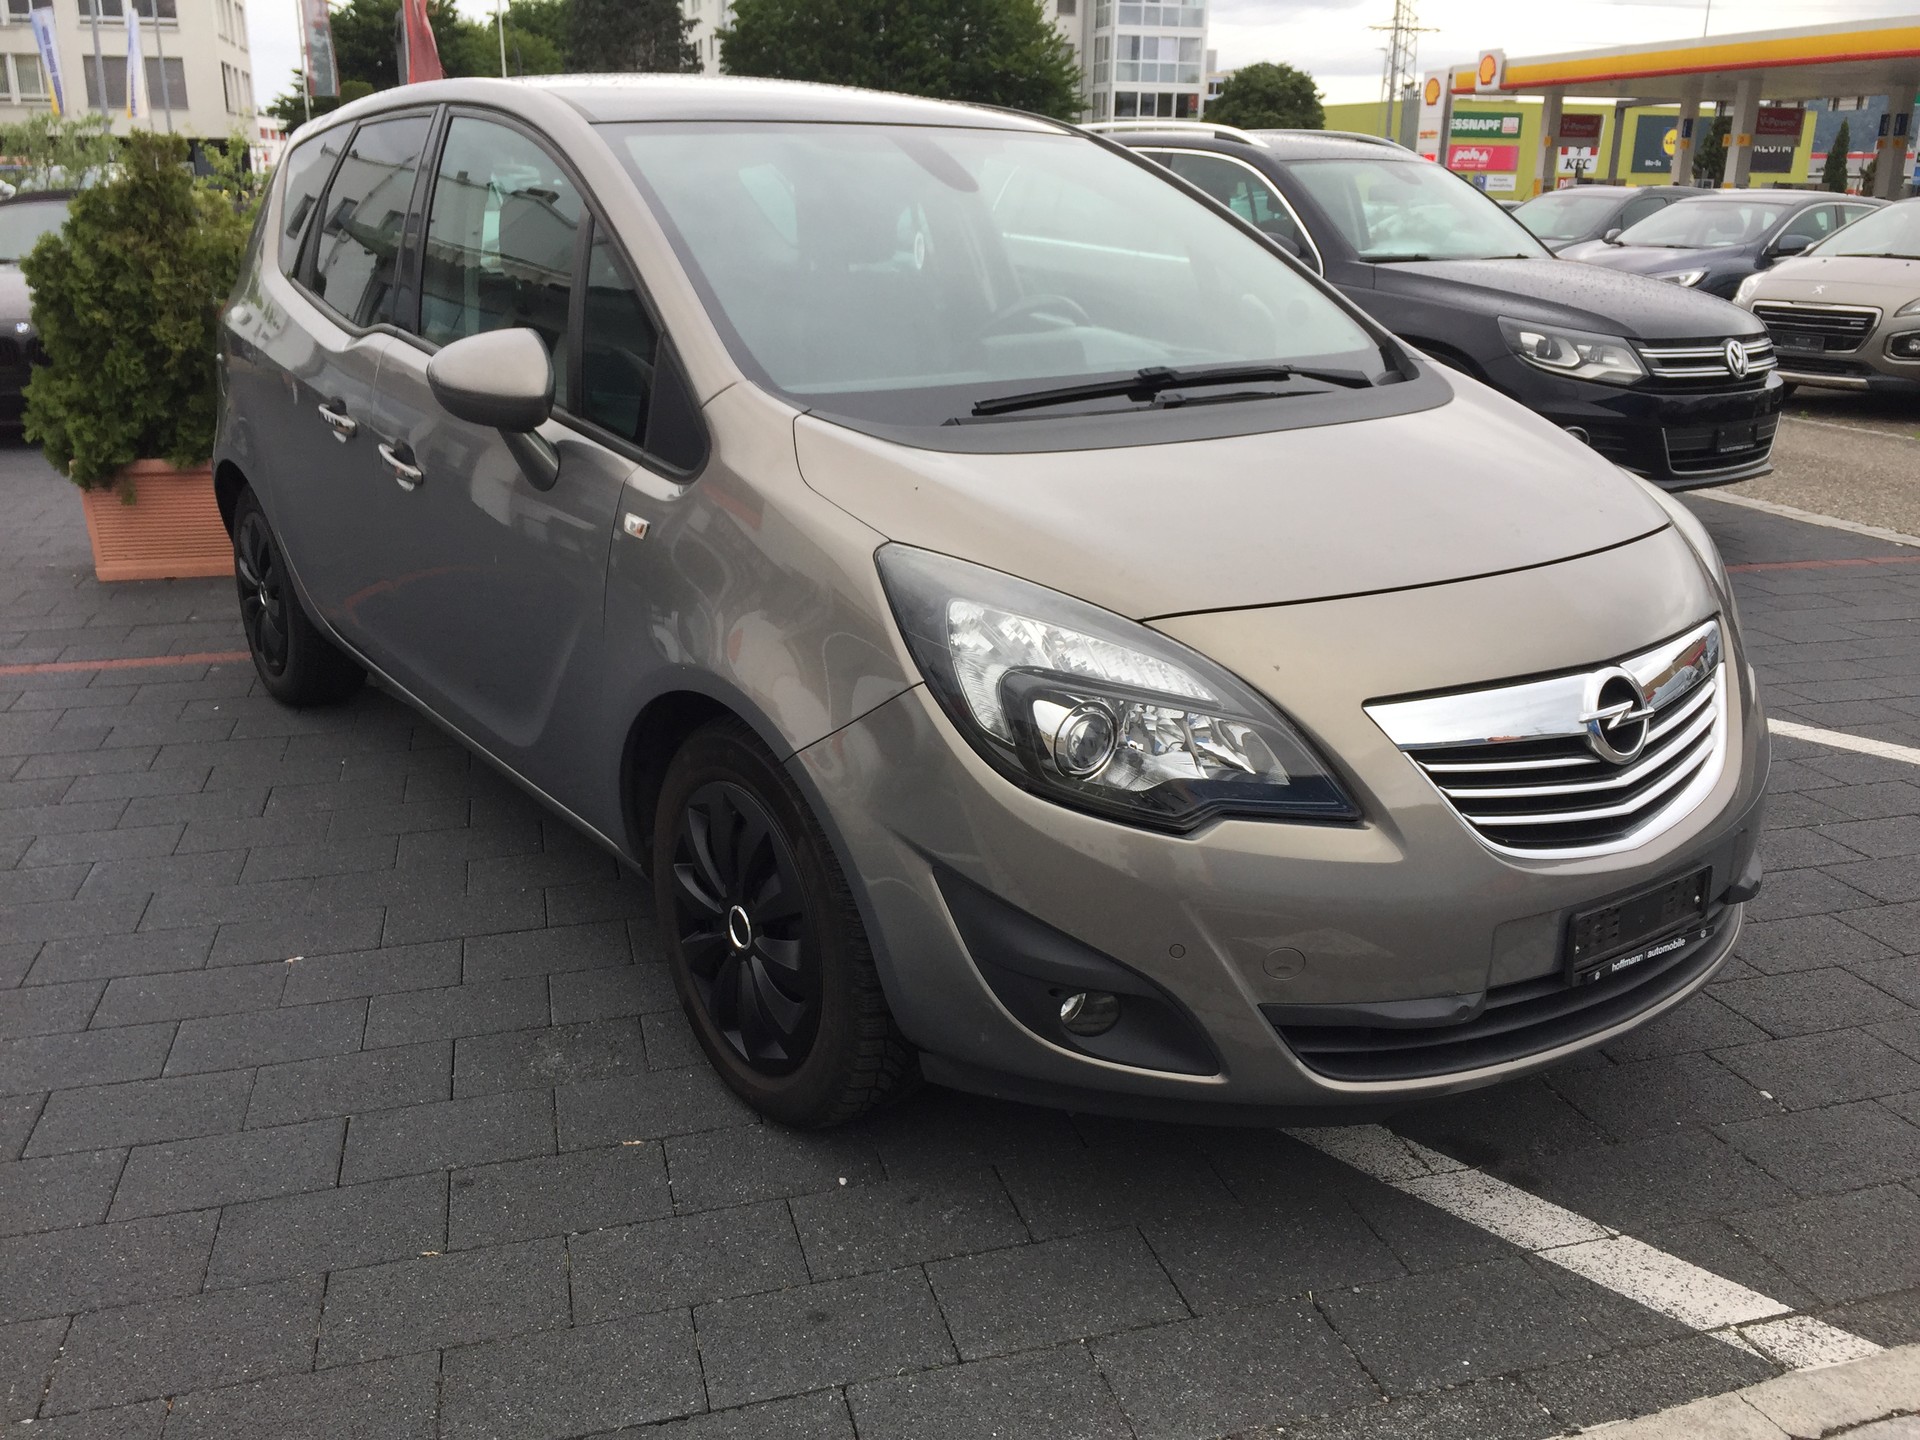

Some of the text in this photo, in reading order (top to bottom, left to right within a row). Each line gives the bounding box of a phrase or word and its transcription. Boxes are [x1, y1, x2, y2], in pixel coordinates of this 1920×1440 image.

[1451, 118, 1501, 130] ESSNAPF
[1564, 158, 1591, 169] KFC
[1612, 938, 1686, 971] hoffmann automobile
